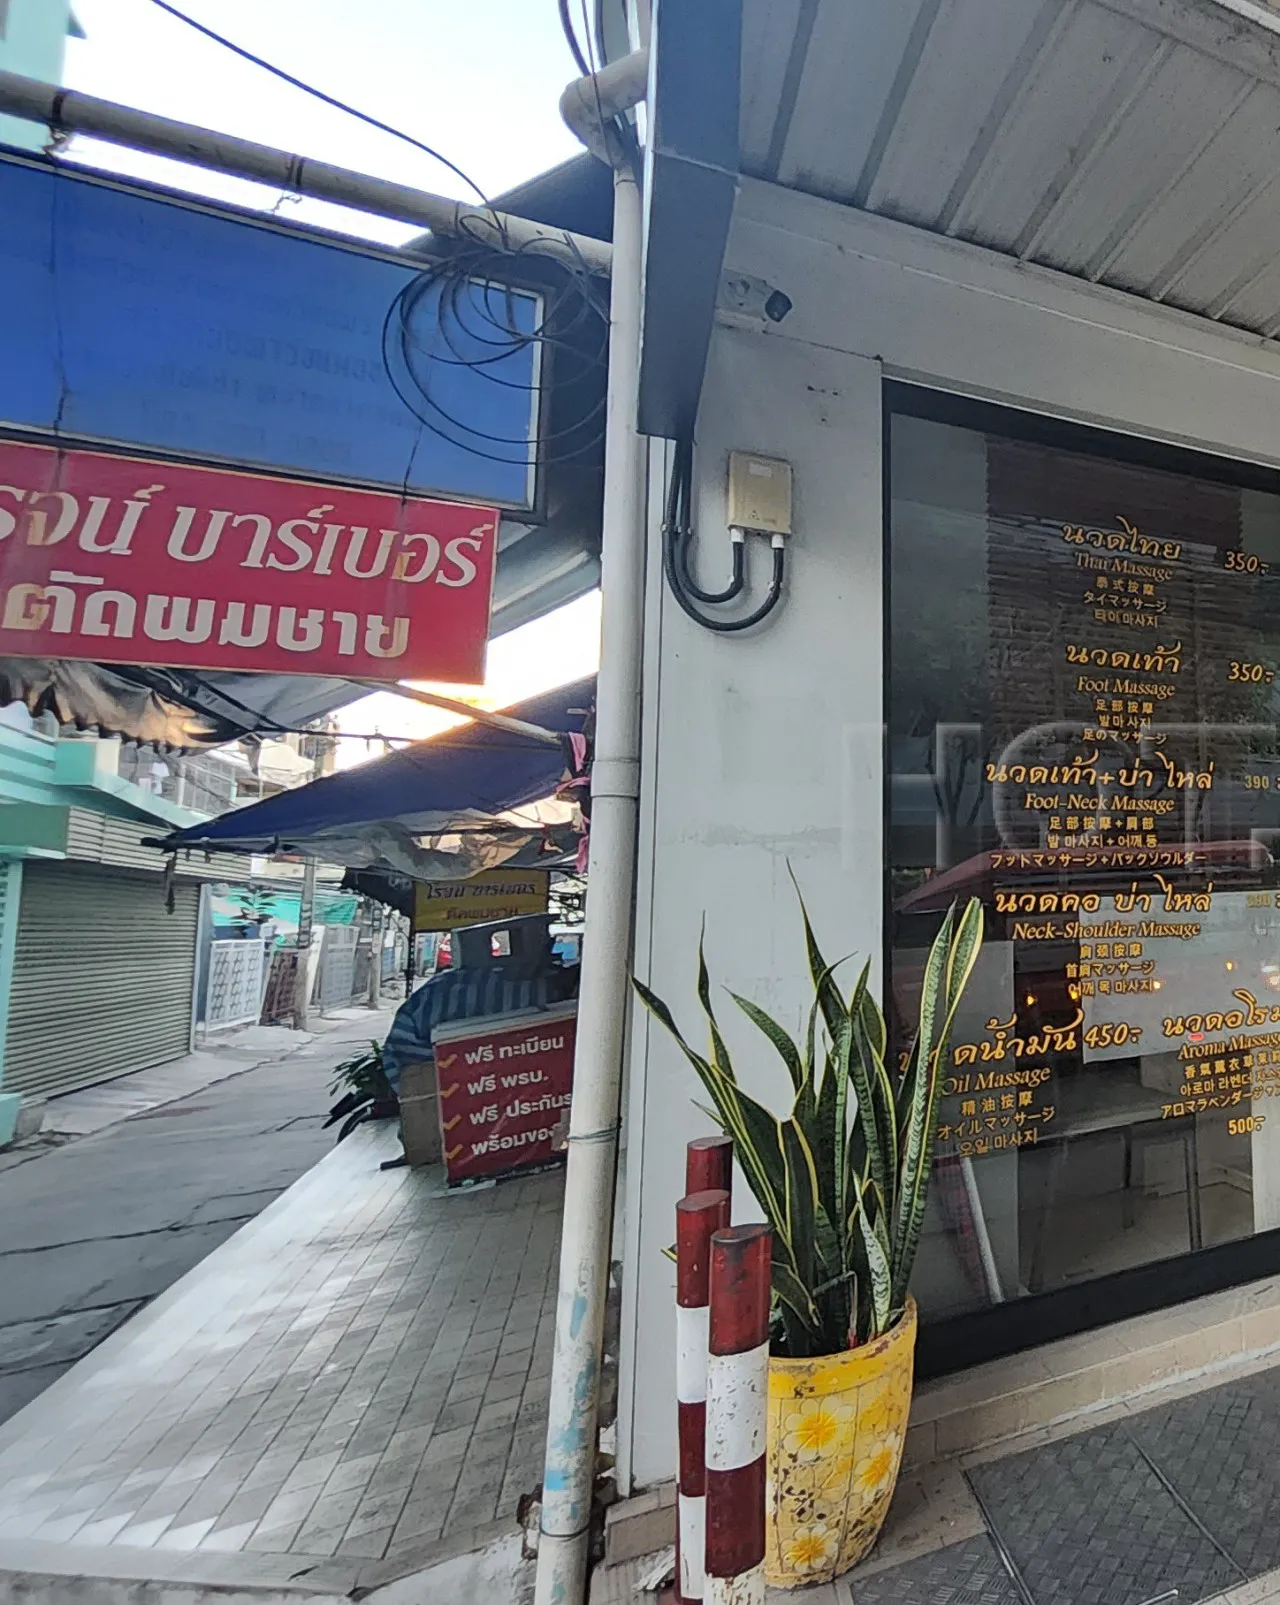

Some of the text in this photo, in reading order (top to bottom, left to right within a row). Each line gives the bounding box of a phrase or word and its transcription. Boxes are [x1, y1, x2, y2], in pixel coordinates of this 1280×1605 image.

[167, 505, 493, 587] บาร์เบอร์
[1062, 515, 1181, 560] นวดไทย
[1075, 552, 1173, 581] Thai Massage
[1, 570, 411, 658] ตัดผมชาย
[1083, 591, 1168, 614] タイマッサージ
[1066, 641, 1181, 673] นวดเท้า
[1077, 676, 1176, 699] Foot Massage
[1110, 795, 1175, 813] Massage
[995, 892, 1099, 912] นวดคอ
[1138, 922, 1201, 938] Massage
[465, 1036, 564, 1065] ฟรี ทะเบียน
[1177, 1042, 1226, 1060] Aroma
[467, 1074, 496, 1095] ฟรี
[974, 1066, 1052, 1092] Massage
[470, 1104, 498, 1125] ฟรี
[961, 1091, 1034, 1117] 精油按摩
[938, 1106, 1055, 1141] オイルマッサージ
